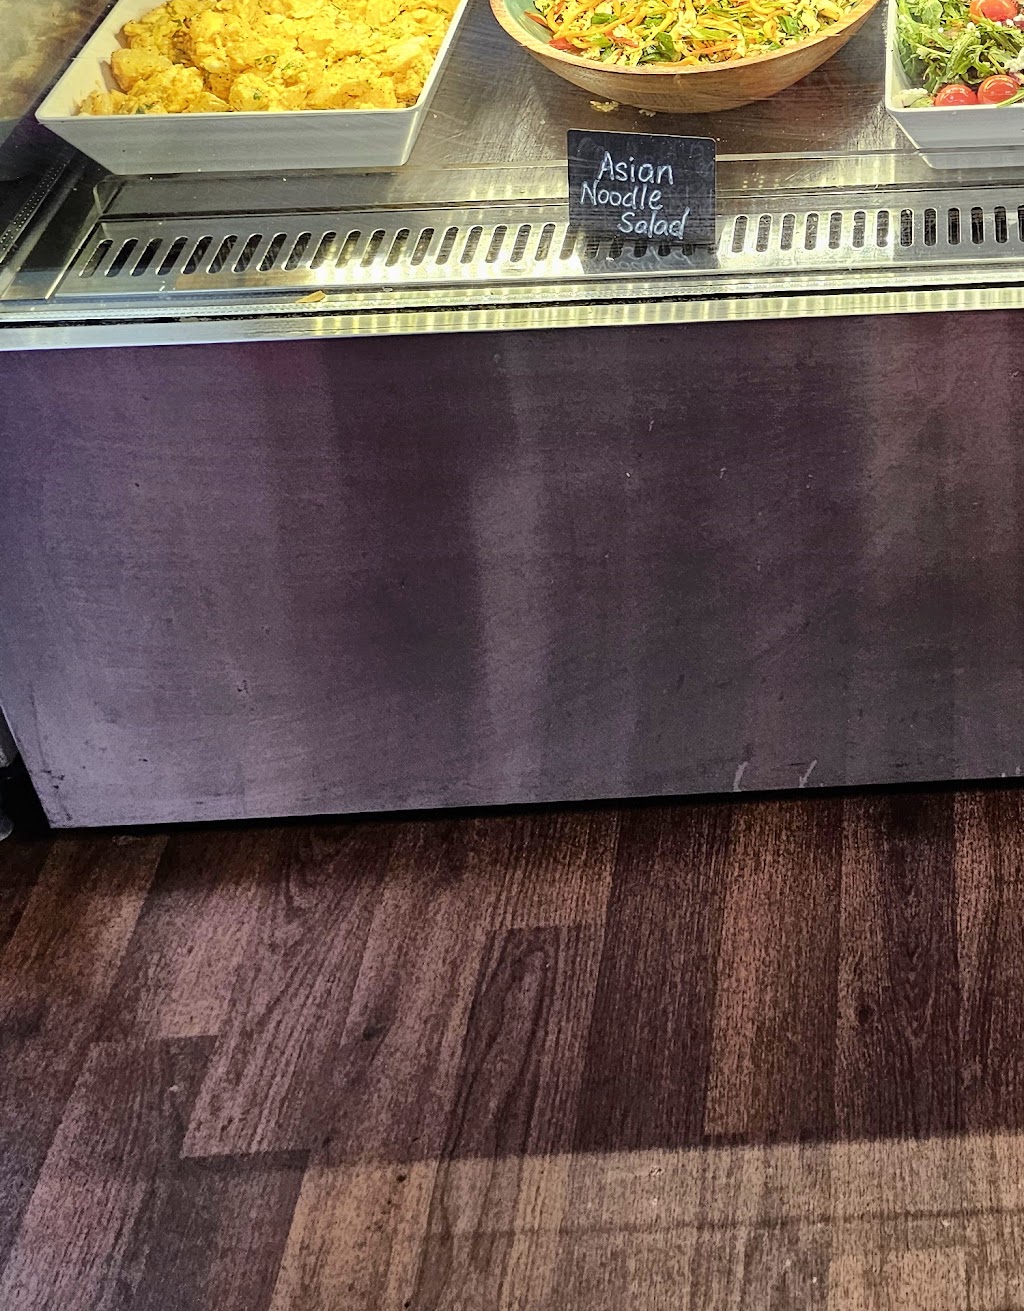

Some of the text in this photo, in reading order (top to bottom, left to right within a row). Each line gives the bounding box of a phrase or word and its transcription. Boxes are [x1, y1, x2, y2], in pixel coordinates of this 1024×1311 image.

[598, 150, 673, 185] Asian
[580, 180, 664, 210] Noodle
[617, 207, 690, 239] Salad
